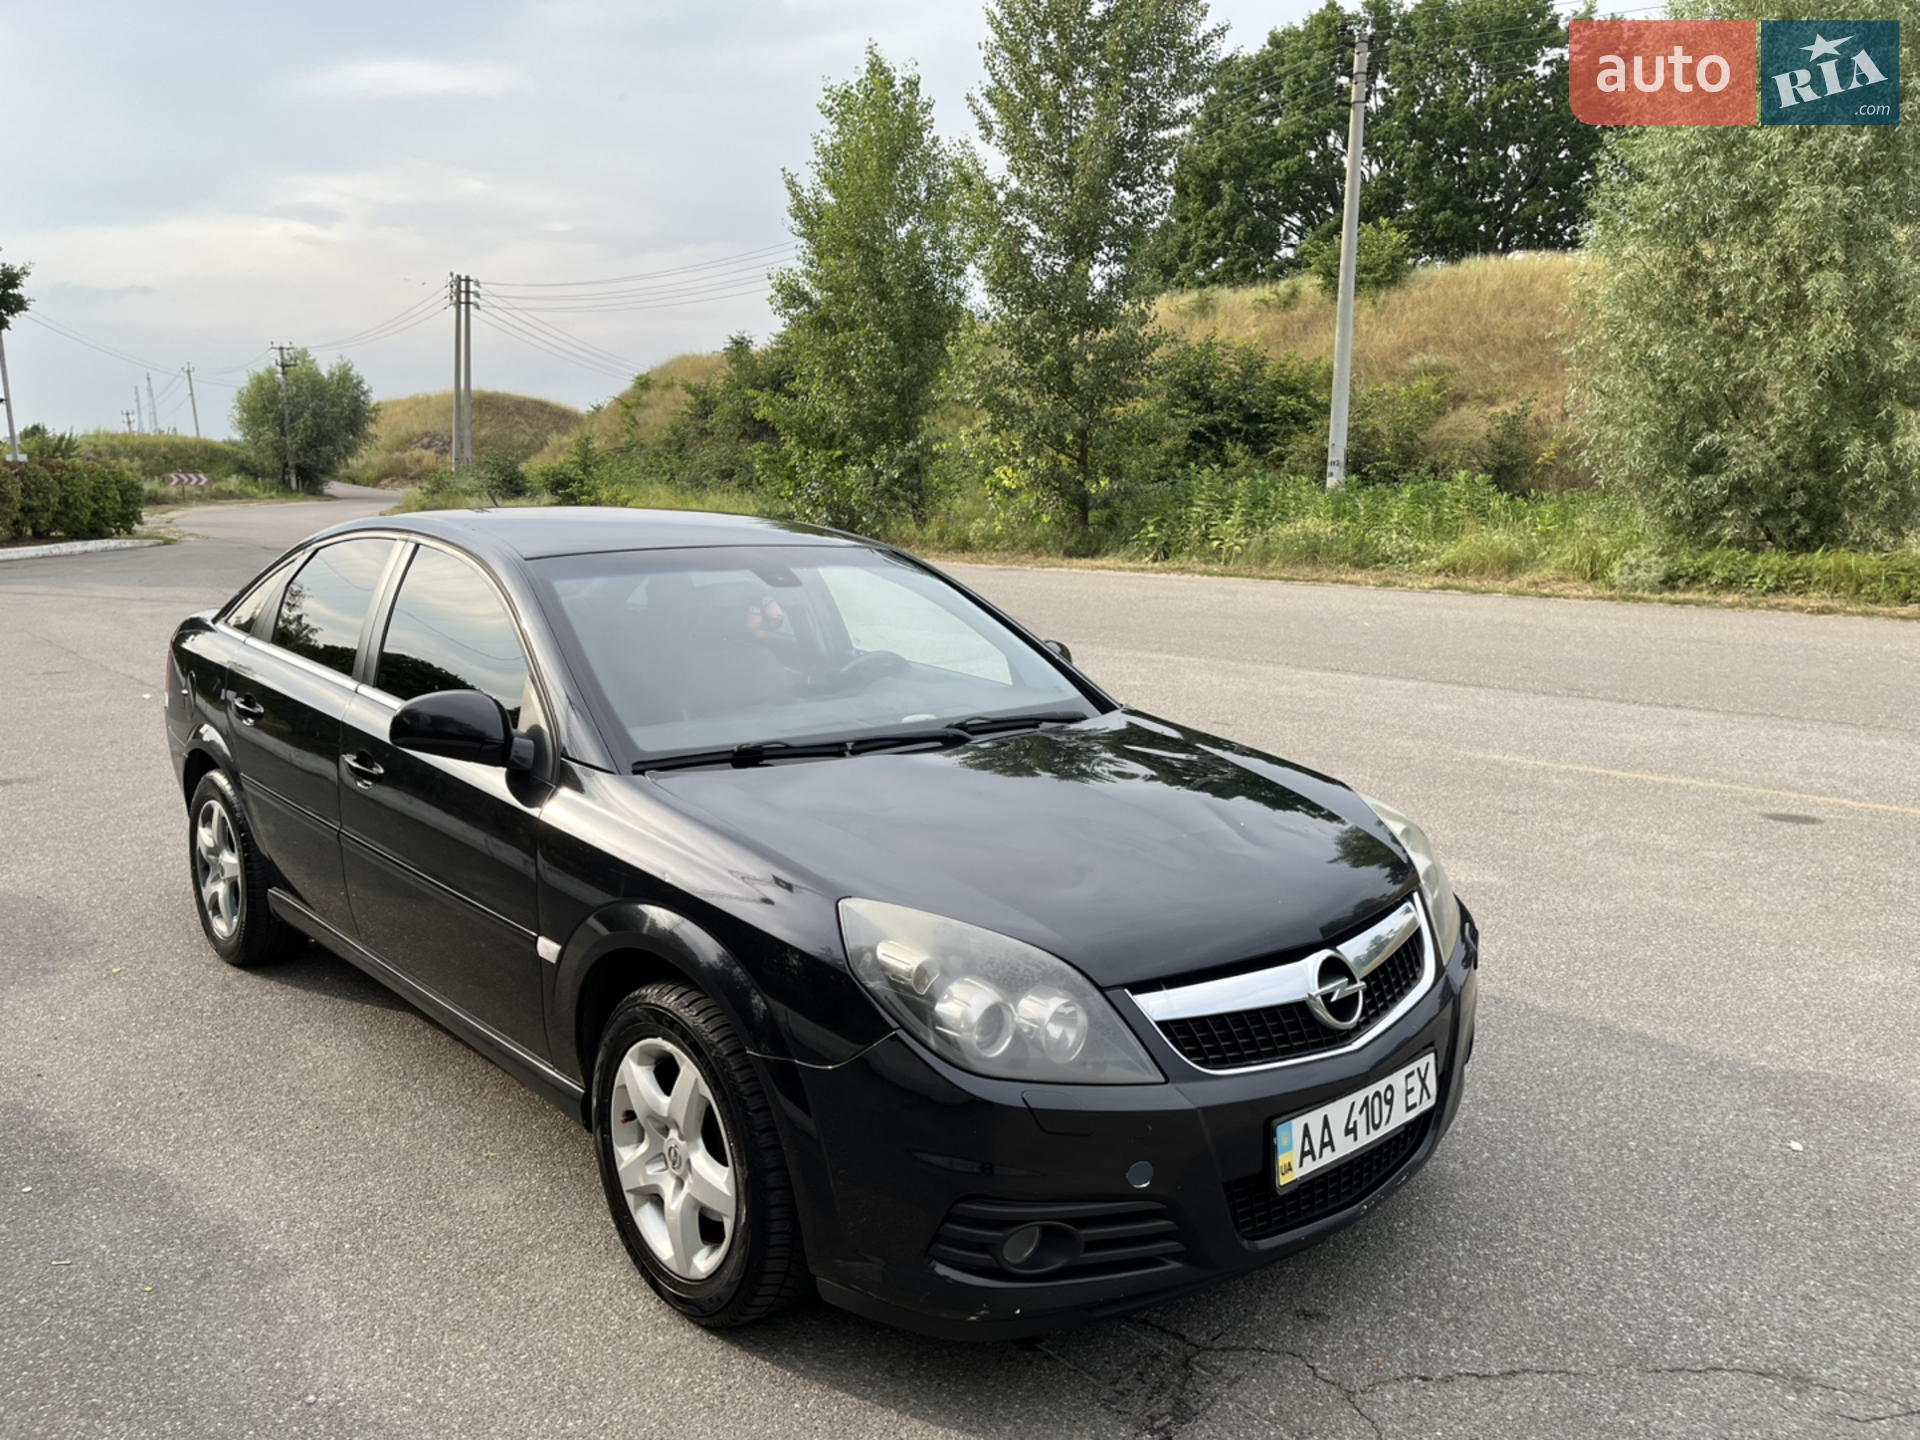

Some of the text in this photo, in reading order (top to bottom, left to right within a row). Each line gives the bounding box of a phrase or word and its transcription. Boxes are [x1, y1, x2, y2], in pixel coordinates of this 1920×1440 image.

[1298, 1061, 1432, 1169] AA 4109 EX
[1279, 1161, 1293, 1176] UA
